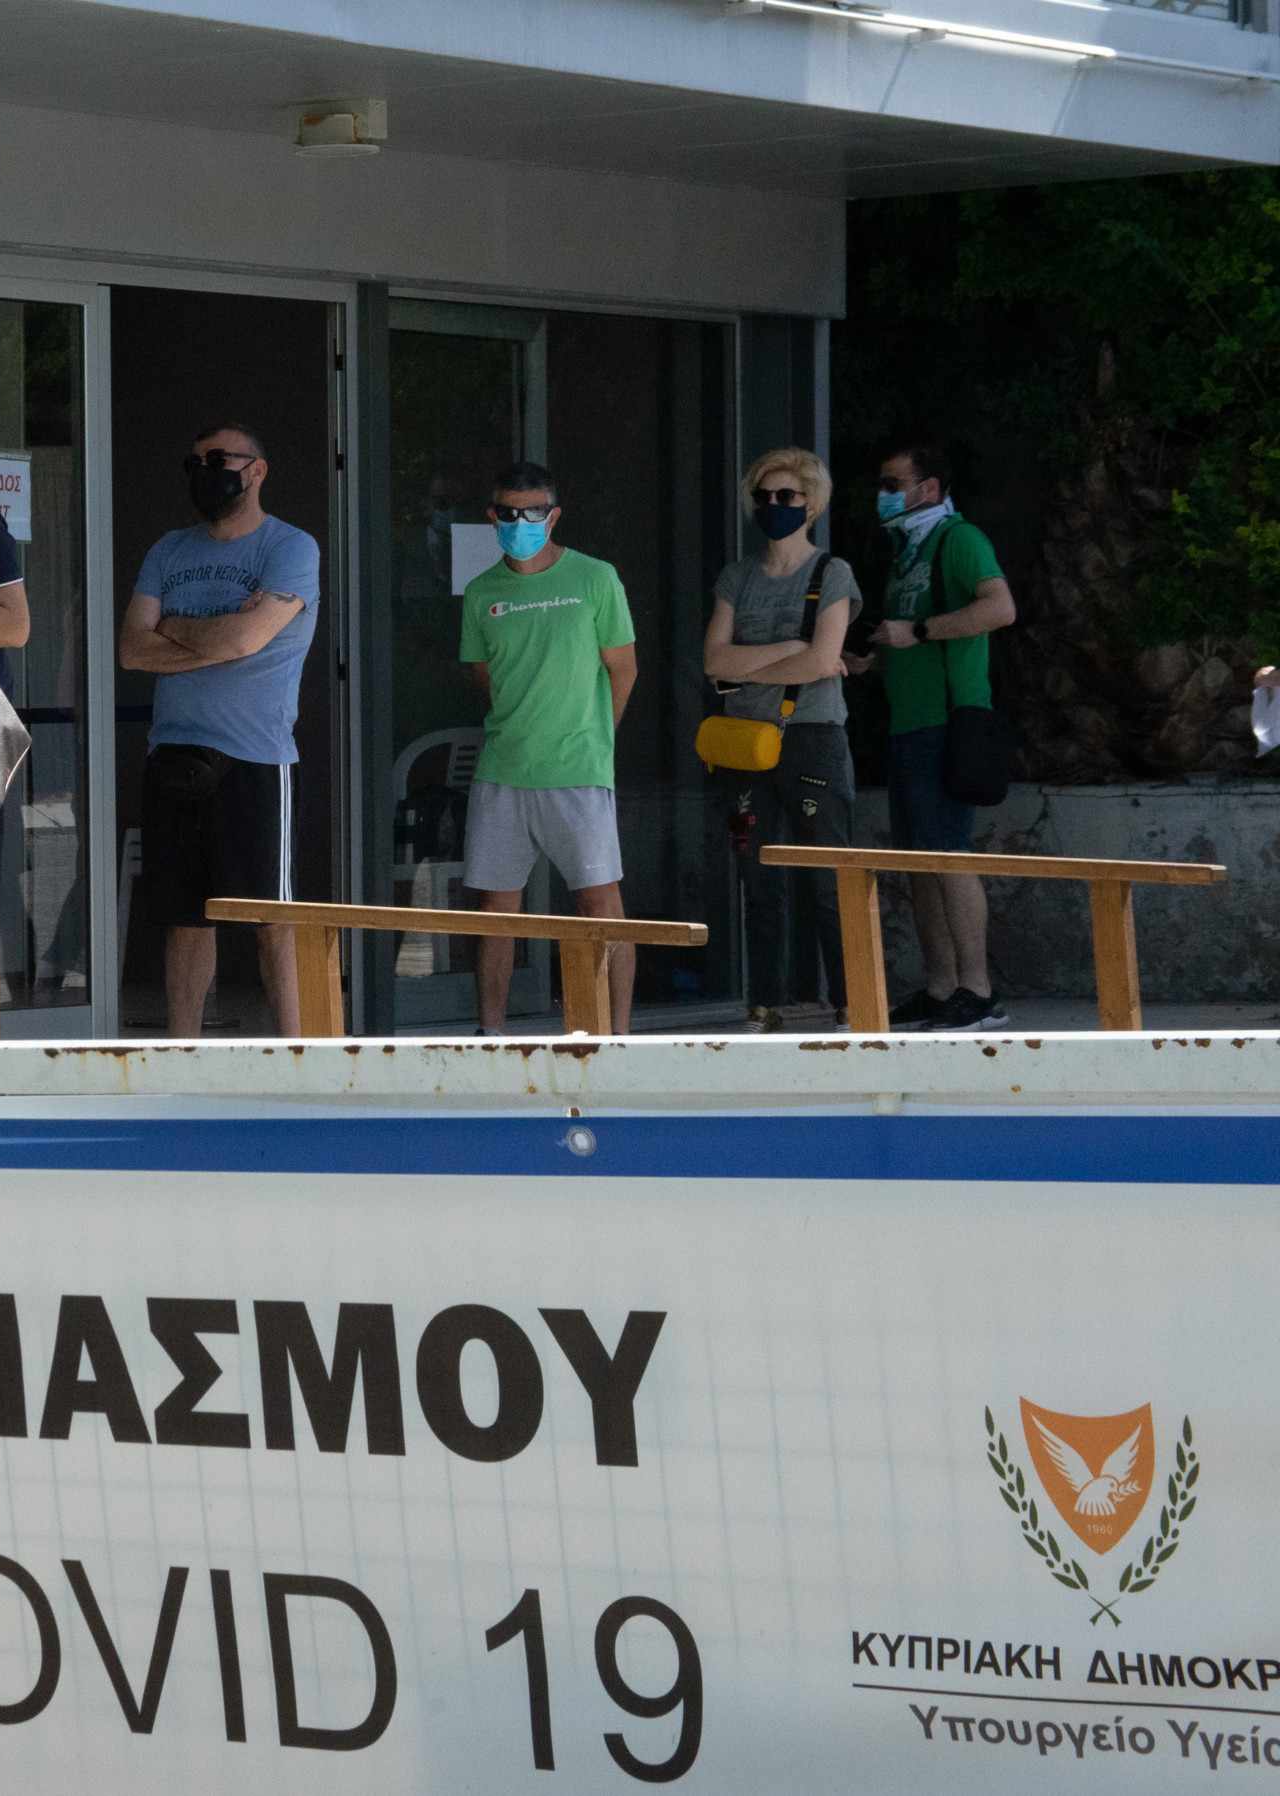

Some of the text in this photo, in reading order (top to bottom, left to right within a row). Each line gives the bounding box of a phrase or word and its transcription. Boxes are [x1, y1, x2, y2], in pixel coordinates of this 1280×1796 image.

[489, 596, 582, 617] Champion
[852, 1631, 1061, 1681] ΚΥΠΡΙΑΚΗ
[485, 1588, 703, 1784] 19
[908, 1703, 1156, 1759] Υπουργείο
